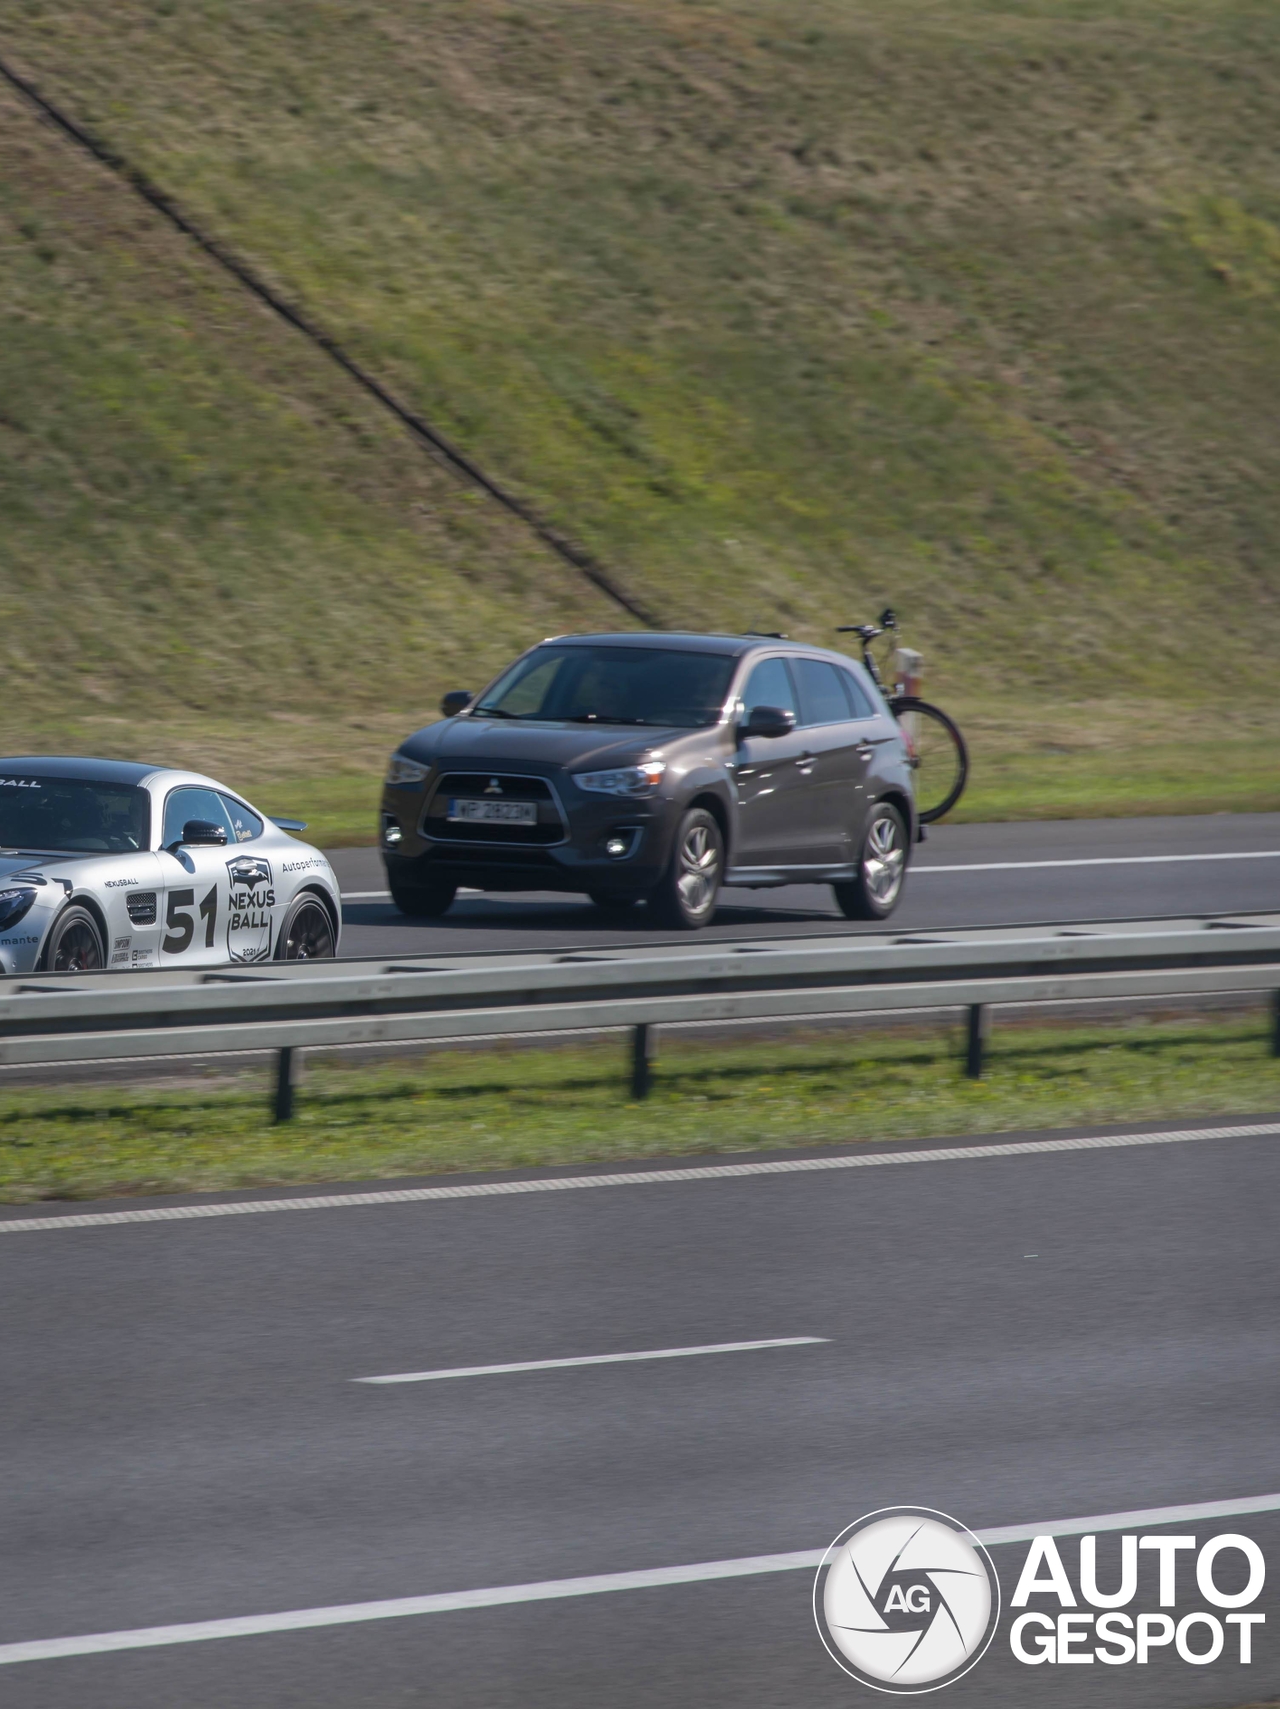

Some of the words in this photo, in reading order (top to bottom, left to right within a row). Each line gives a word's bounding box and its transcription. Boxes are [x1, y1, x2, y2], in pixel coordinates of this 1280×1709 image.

[104, 878, 139, 888] NEXUSBALL
[228, 889, 276, 911] NEXUS
[162, 882, 218, 955] 51
[231, 911, 269, 931] BALL
